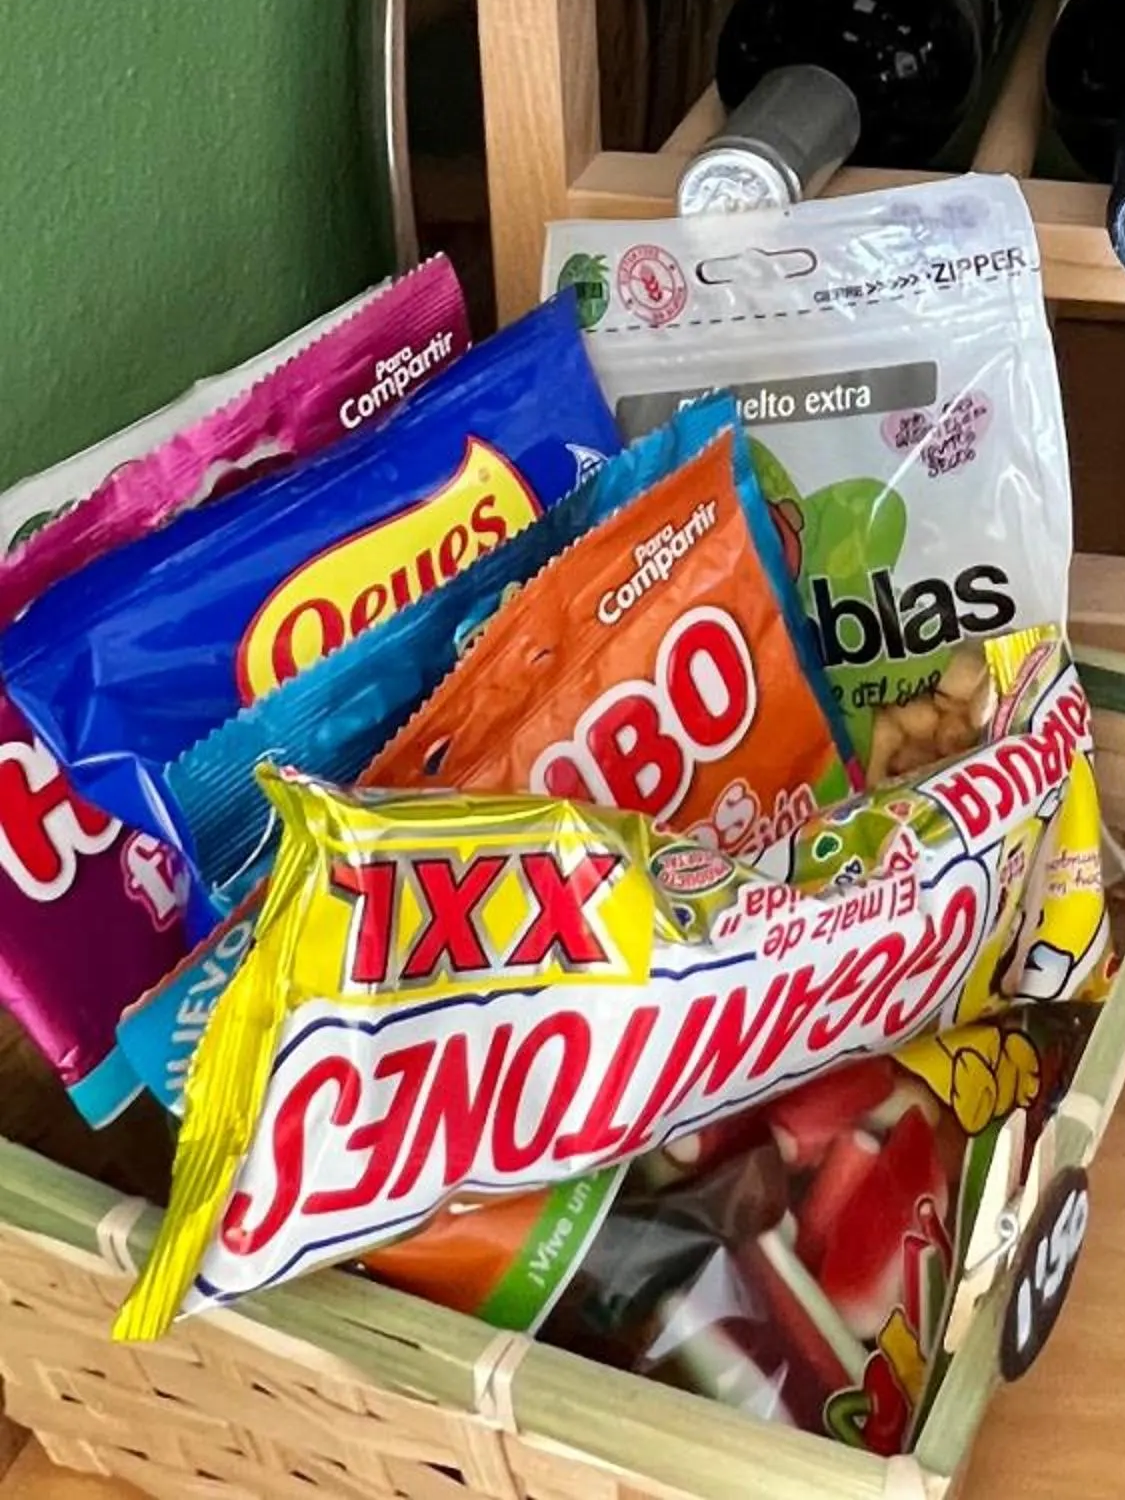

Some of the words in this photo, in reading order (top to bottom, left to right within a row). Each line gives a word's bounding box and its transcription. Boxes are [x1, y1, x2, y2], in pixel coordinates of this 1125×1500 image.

[931, 247, 1027, 284] ZIPPER
[340, 331, 453, 429] Compartir
[375, 346, 413, 380] Para
[804, 383, 872, 413] extra
[597, 499, 717, 625] Compartir
[634, 523, 675, 566] Para
[330, 853, 622, 984] XXL
[888, 874, 918, 920] El
[762, 916, 806, 960] de
